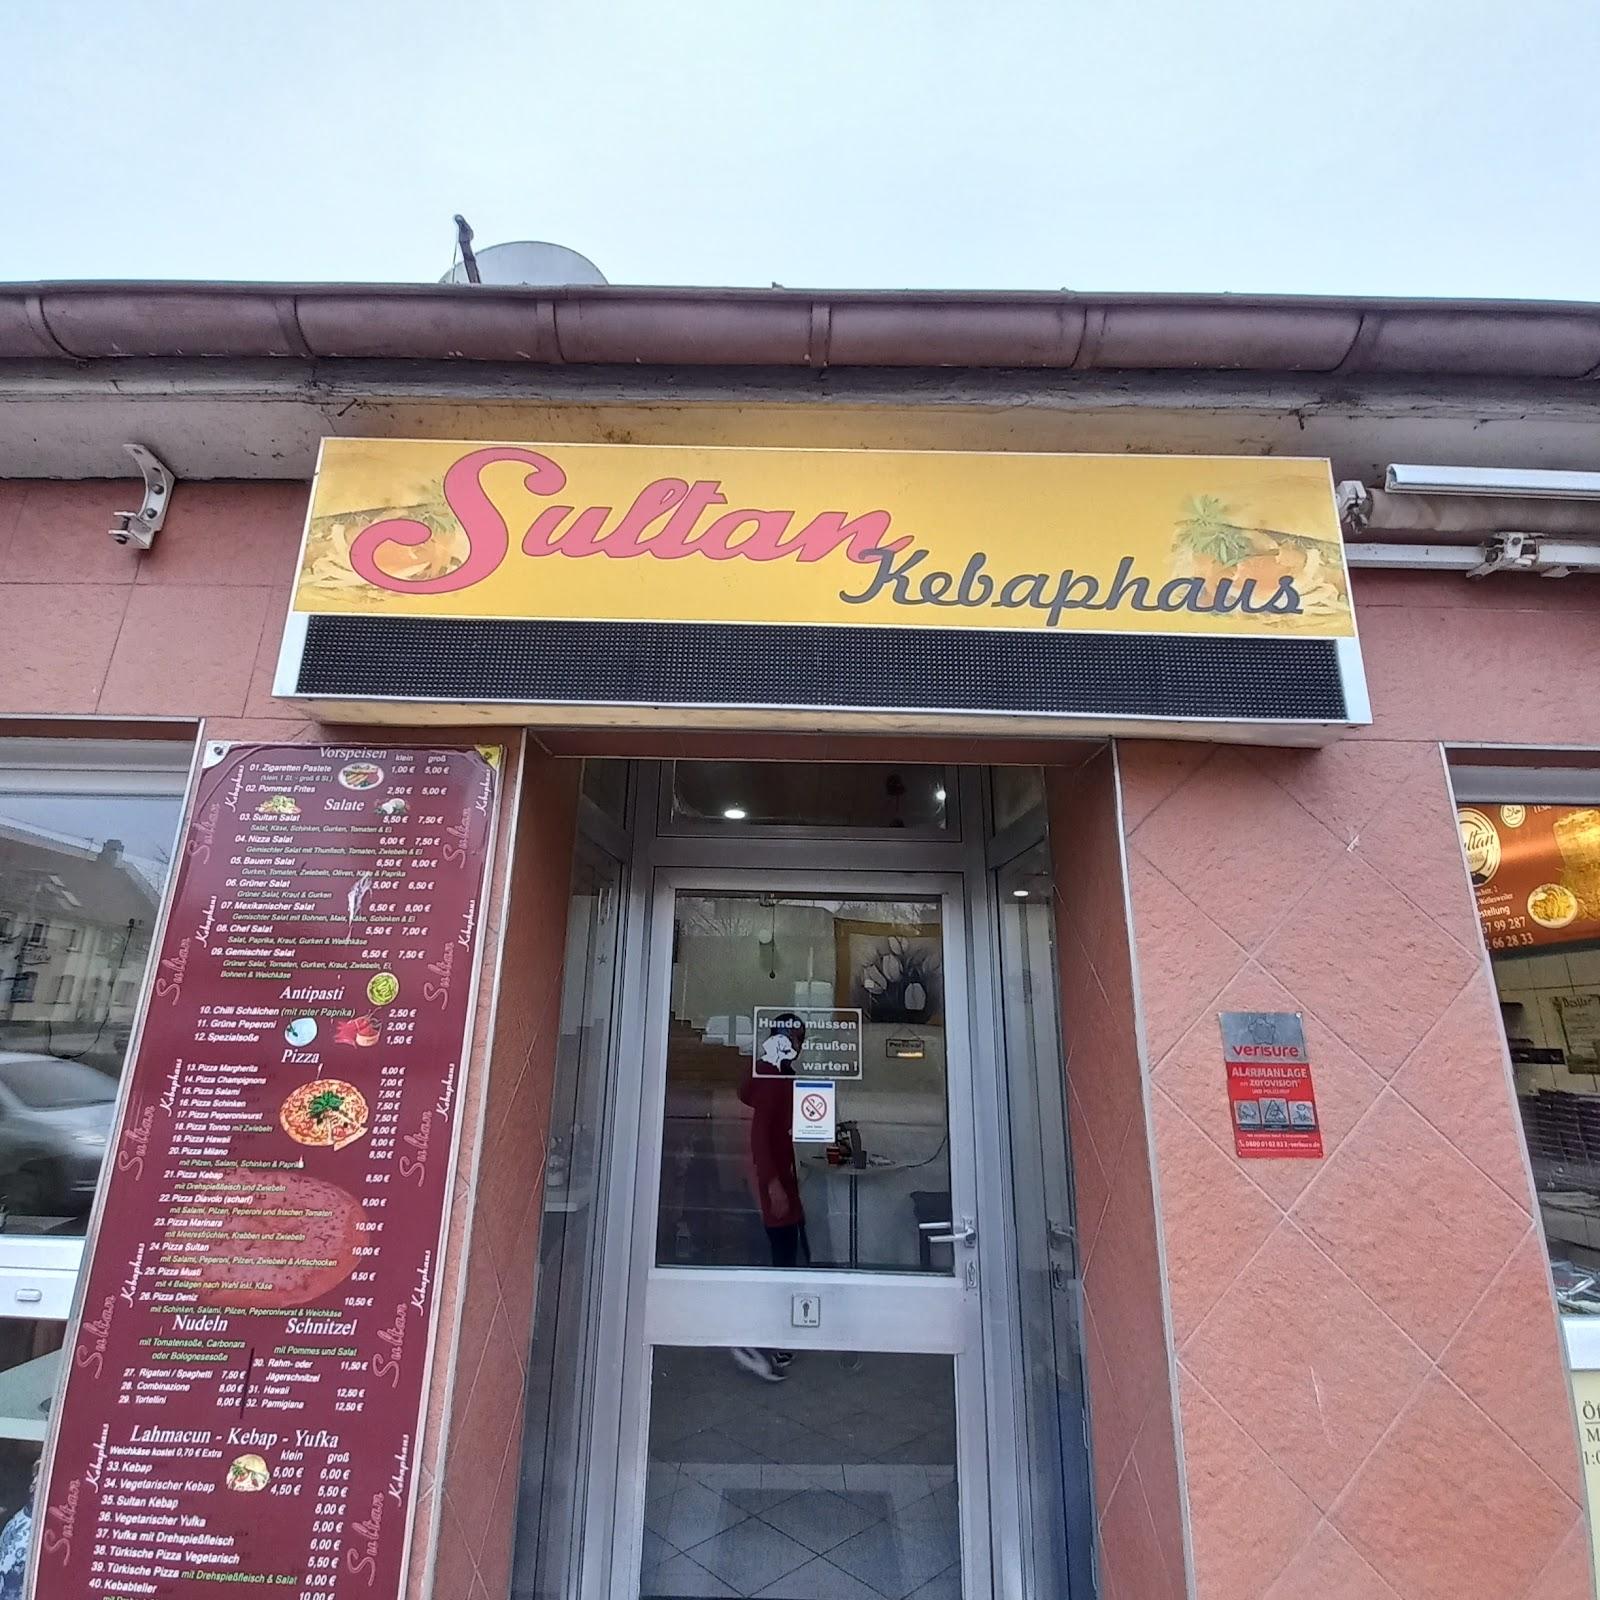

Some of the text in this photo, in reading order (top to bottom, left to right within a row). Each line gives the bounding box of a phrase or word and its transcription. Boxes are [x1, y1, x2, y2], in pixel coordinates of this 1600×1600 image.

[349, 447, 915, 595] Sultan
[839, 548, 1304, 627] Kebaphaus
[320, 747, 387, 759] Vorspeisen
[395, 754, 446, 763] klein groß
[249, 764, 261, 772] 01.
[262, 764, 300, 773] Zigaretten
[391, 766, 407, 774] 1,00
[425, 766, 440, 775] 5,00
[224, 765, 245, 812] Kebaphaus
[259, 785, 291, 793] Pommes
[294, 785, 315, 793] Frites
[475, 769, 491, 816] Kebaphaus
[324, 799, 364, 811] Salate
[253, 814, 277, 822] Sultan
[279, 814, 300, 822] Salat
[188, 803, 220, 864] Sultan
[442, 806, 472, 869] Sultan
[1462, 832, 1494, 852] ltan
[225, 879, 290, 888] 06. Grüner Salat
[220, 902, 315, 911] 07. Mexikanischer Salat
[1479, 906, 1510, 918] stellung
[195, 895, 216, 948] Kebaphaus
[458, 899, 475, 952] Kebaphaus
[1508, 916, 1526, 929] 287
[230, 925, 251, 933] Chef
[252, 925, 273, 933] Salat
[1506, 935, 1519, 947] 28
[1520, 933, 1534, 945] 33
[211, 948, 295, 957] 09. Gemischter Salat
[156, 937, 190, 1006] Sultan
[424, 941, 454, 1010] Sultan
[279, 986, 345, 1002] Antipasti
[200, 1006, 212, 1014] 10.
[213, 1006, 234, 1015] Chilli
[236, 1006, 279, 1016] Schälchen
[409, 1010, 416, 1018] €
[197, 1020, 277, 1030] 11. Grüne Peperoni
[759, 1018, 856, 1029] Hunde müssen
[194, 1033, 259, 1043] 12. Spezialsoße
[802, 1039, 856, 1051] draußen
[282, 1049, 319, 1064] Pizza
[1233, 1045, 1298, 1057] verisure
[219, 1064, 258, 1073] Margherita
[803, 1061, 849, 1071] warten
[1232, 1067, 1307, 1078] ALARMANLAGE
[217, 1076, 267, 1085] Champignons
[159, 1059, 182, 1117] Kebaphaus
[215, 1088, 240, 1096] Salami
[436, 1063, 455, 1122] Kebaphaus
[210, 1112, 263, 1120] Peperoniwurst
[118, 1105, 155, 1181] Sultan
[400, 1110, 432, 1187] Sultan
[120, 1242, 145, 1308] Kebaphaus
[410, 1249, 431, 1317] Kebaphaus
[172, 1315, 228, 1332] Nudeln
[285, 1318, 358, 1336] Schnitzel
[77, 1295, 115, 1379] Sultan
[373, 1303, 407, 1389] Sultan
[139, 1369, 171, 1379] Rigatoni
[177, 1370, 213, 1380] Spaghetti
[137, 1382, 190, 1392] Combinazione
[130, 1425, 211, 1443] Lahmacun
[227, 1428, 278, 1450] Kebap
[294, 1430, 339, 1448] Yufka
[86, 1423, 110, 1494] Kebaphaus
[281, 1450, 349, 1463] klein groß
[107, 1461, 152, 1474] 33. Kebap
[273, 1467, 304, 1478] 5,00 €
[320, 1469, 350, 1479] 6,00 €
[388, 1434, 409, 1508] Kebaphaus
[104, 1478, 215, 1493] 34. Vegetarischer Kebap
[101, 1495, 178, 1510] 35. Sultan Kebap
[337, 1505, 345, 1515] €
[45, 1478, 80, 1566] Sultan
[115, 1513, 178, 1526] Vegetarischer
[180, 1515, 206, 1528] Yufka
[96, 1528, 235, 1546] 37. Yufka mit Drehspießfleisch
[347, 1492, 385, 1586] Sultan
[109, 1546, 153, 1559] Türkische
[156, 1549, 181, 1561] Pizza
[185, 1551, 240, 1565] Vegetarisch
[91, 1562, 106, 1572] 39.
[107, 1563, 151, 1576] Türkische
[153, 1566, 179, 1578] Pizza
[181, 1568, 195, 1579] mit
[89, 1578, 158, 1593] 40. Kebabteller
